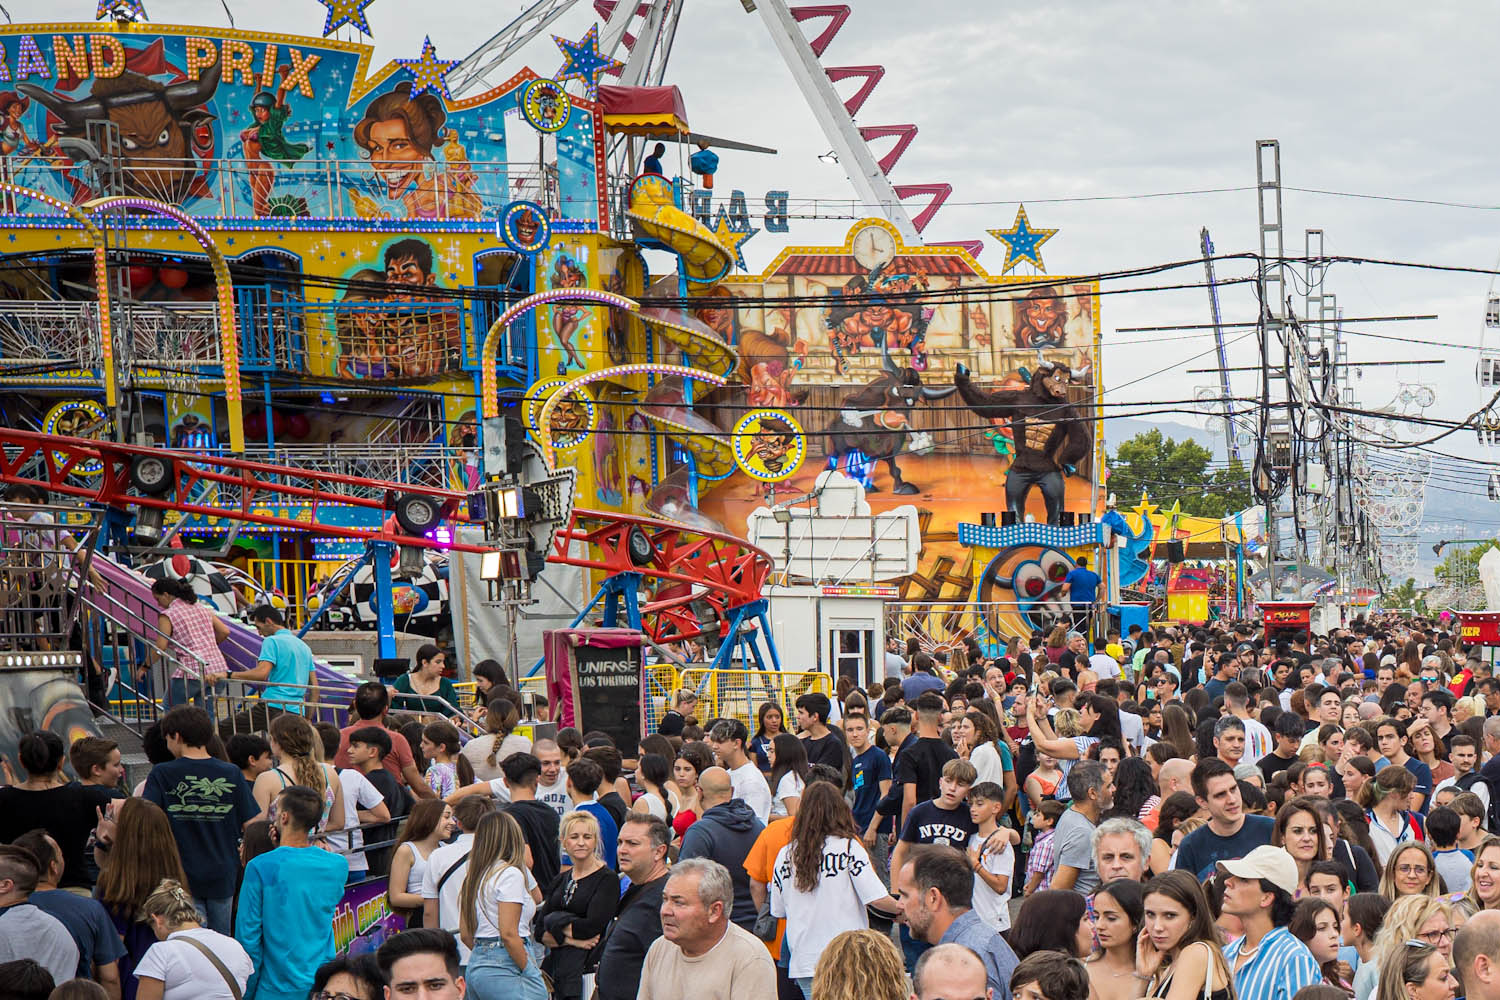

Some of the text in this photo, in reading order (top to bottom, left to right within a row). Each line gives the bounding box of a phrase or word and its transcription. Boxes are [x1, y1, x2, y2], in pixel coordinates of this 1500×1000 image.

[185, 36, 322, 99] PRIX
[578, 660, 638, 674] UNIFASE
[579, 674, 639, 687] LOS TORIBIOS
[167, 804, 234, 814] seed
[918, 823, 967, 842] NYPD
